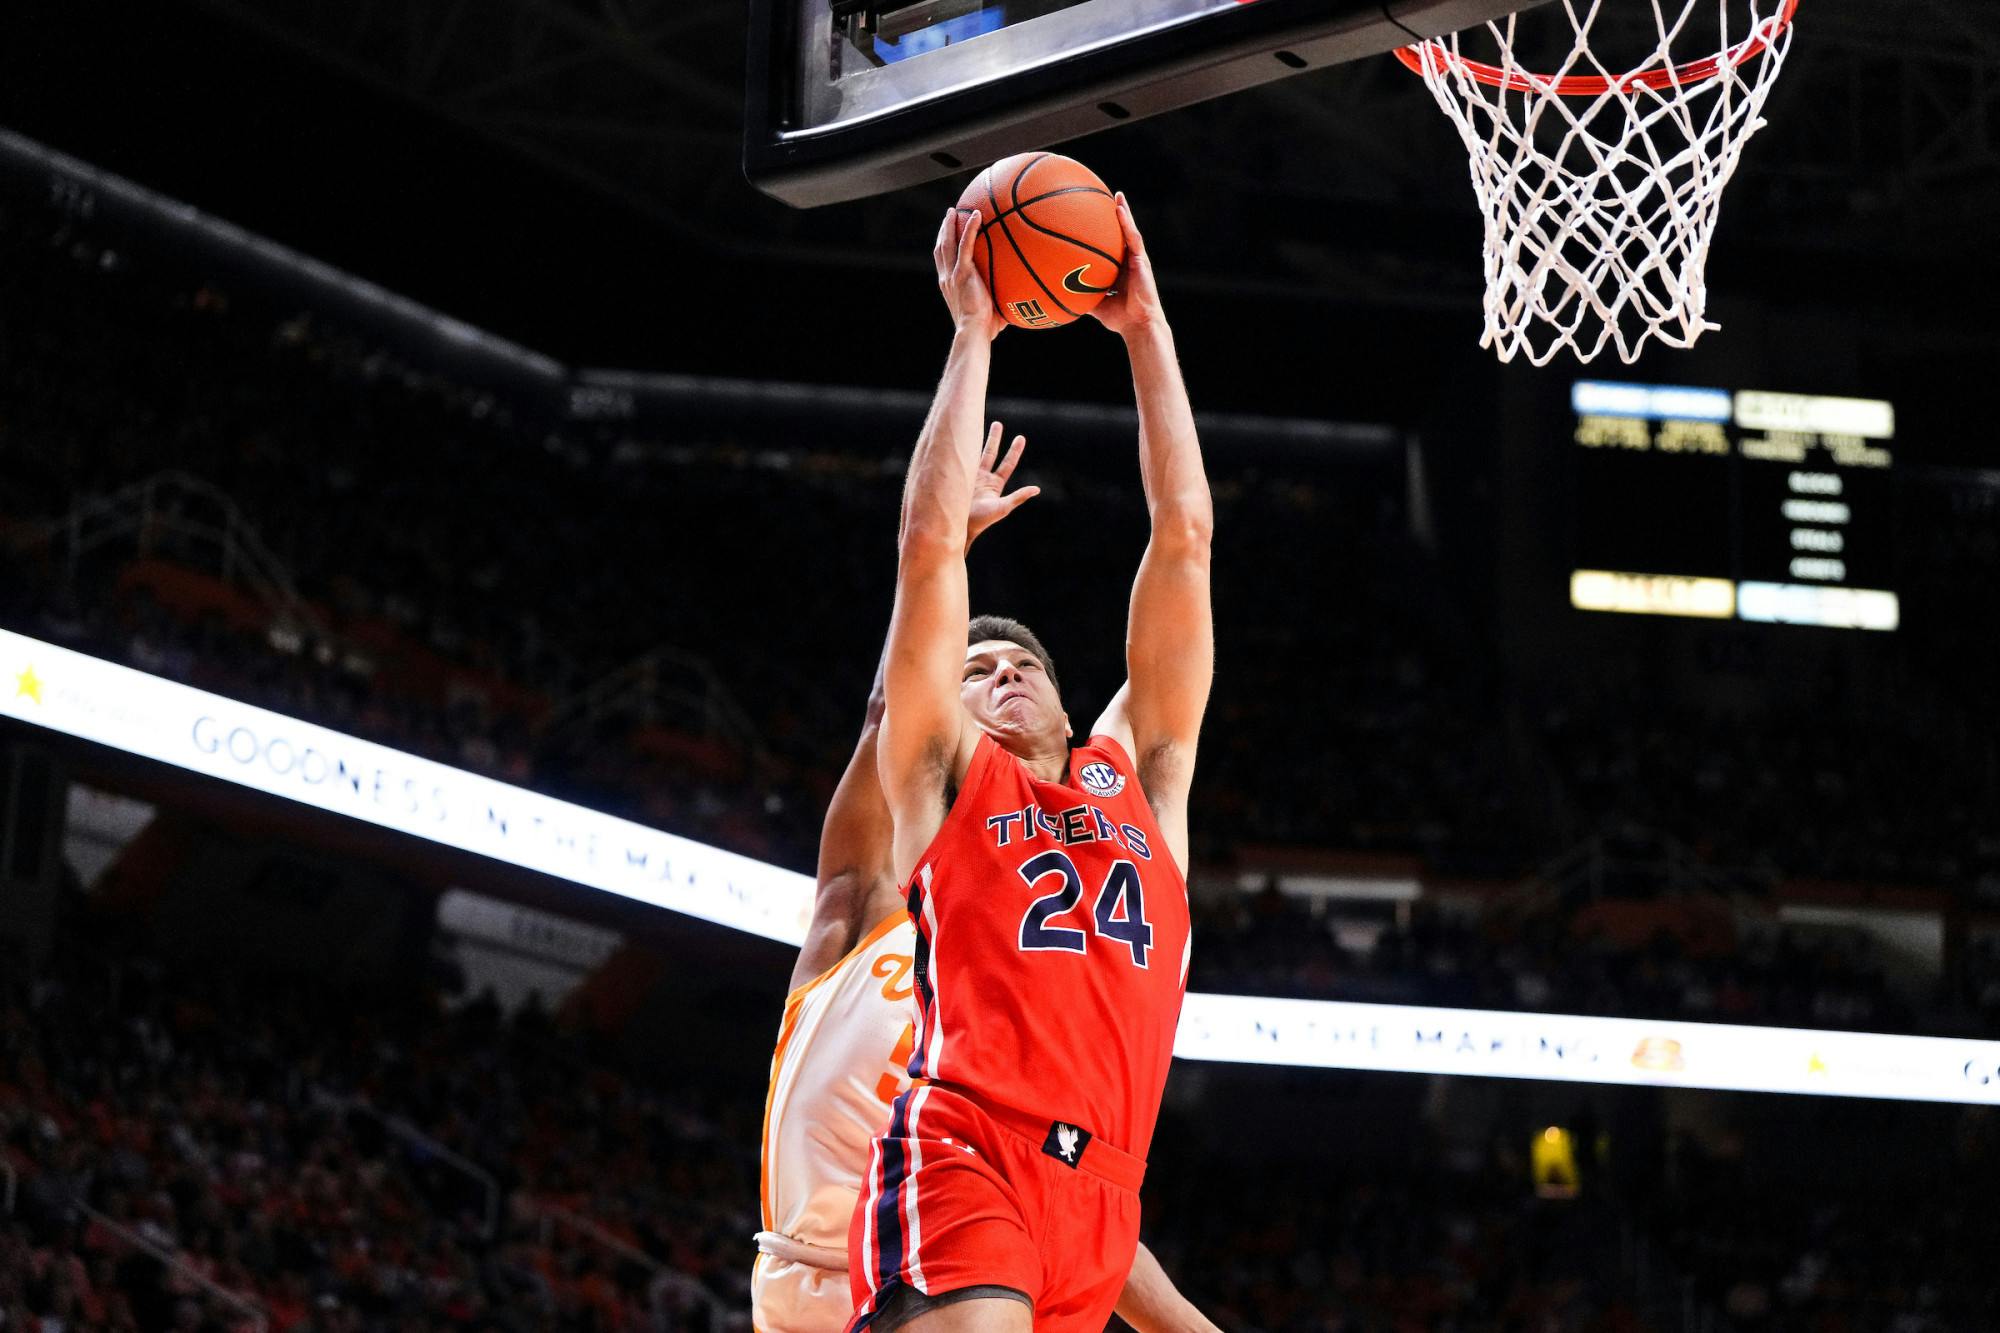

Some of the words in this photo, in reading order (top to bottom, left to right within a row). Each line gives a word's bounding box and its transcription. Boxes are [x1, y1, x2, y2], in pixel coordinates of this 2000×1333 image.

[1081, 763, 1116, 789] SEC
[191, 715, 448, 823] GOODNESS
[623, 843, 771, 919] MAKN
[986, 803, 1152, 860] TIGERS
[1017, 848, 1155, 969] 24
[1414, 1027, 1600, 1064] MAKNG
